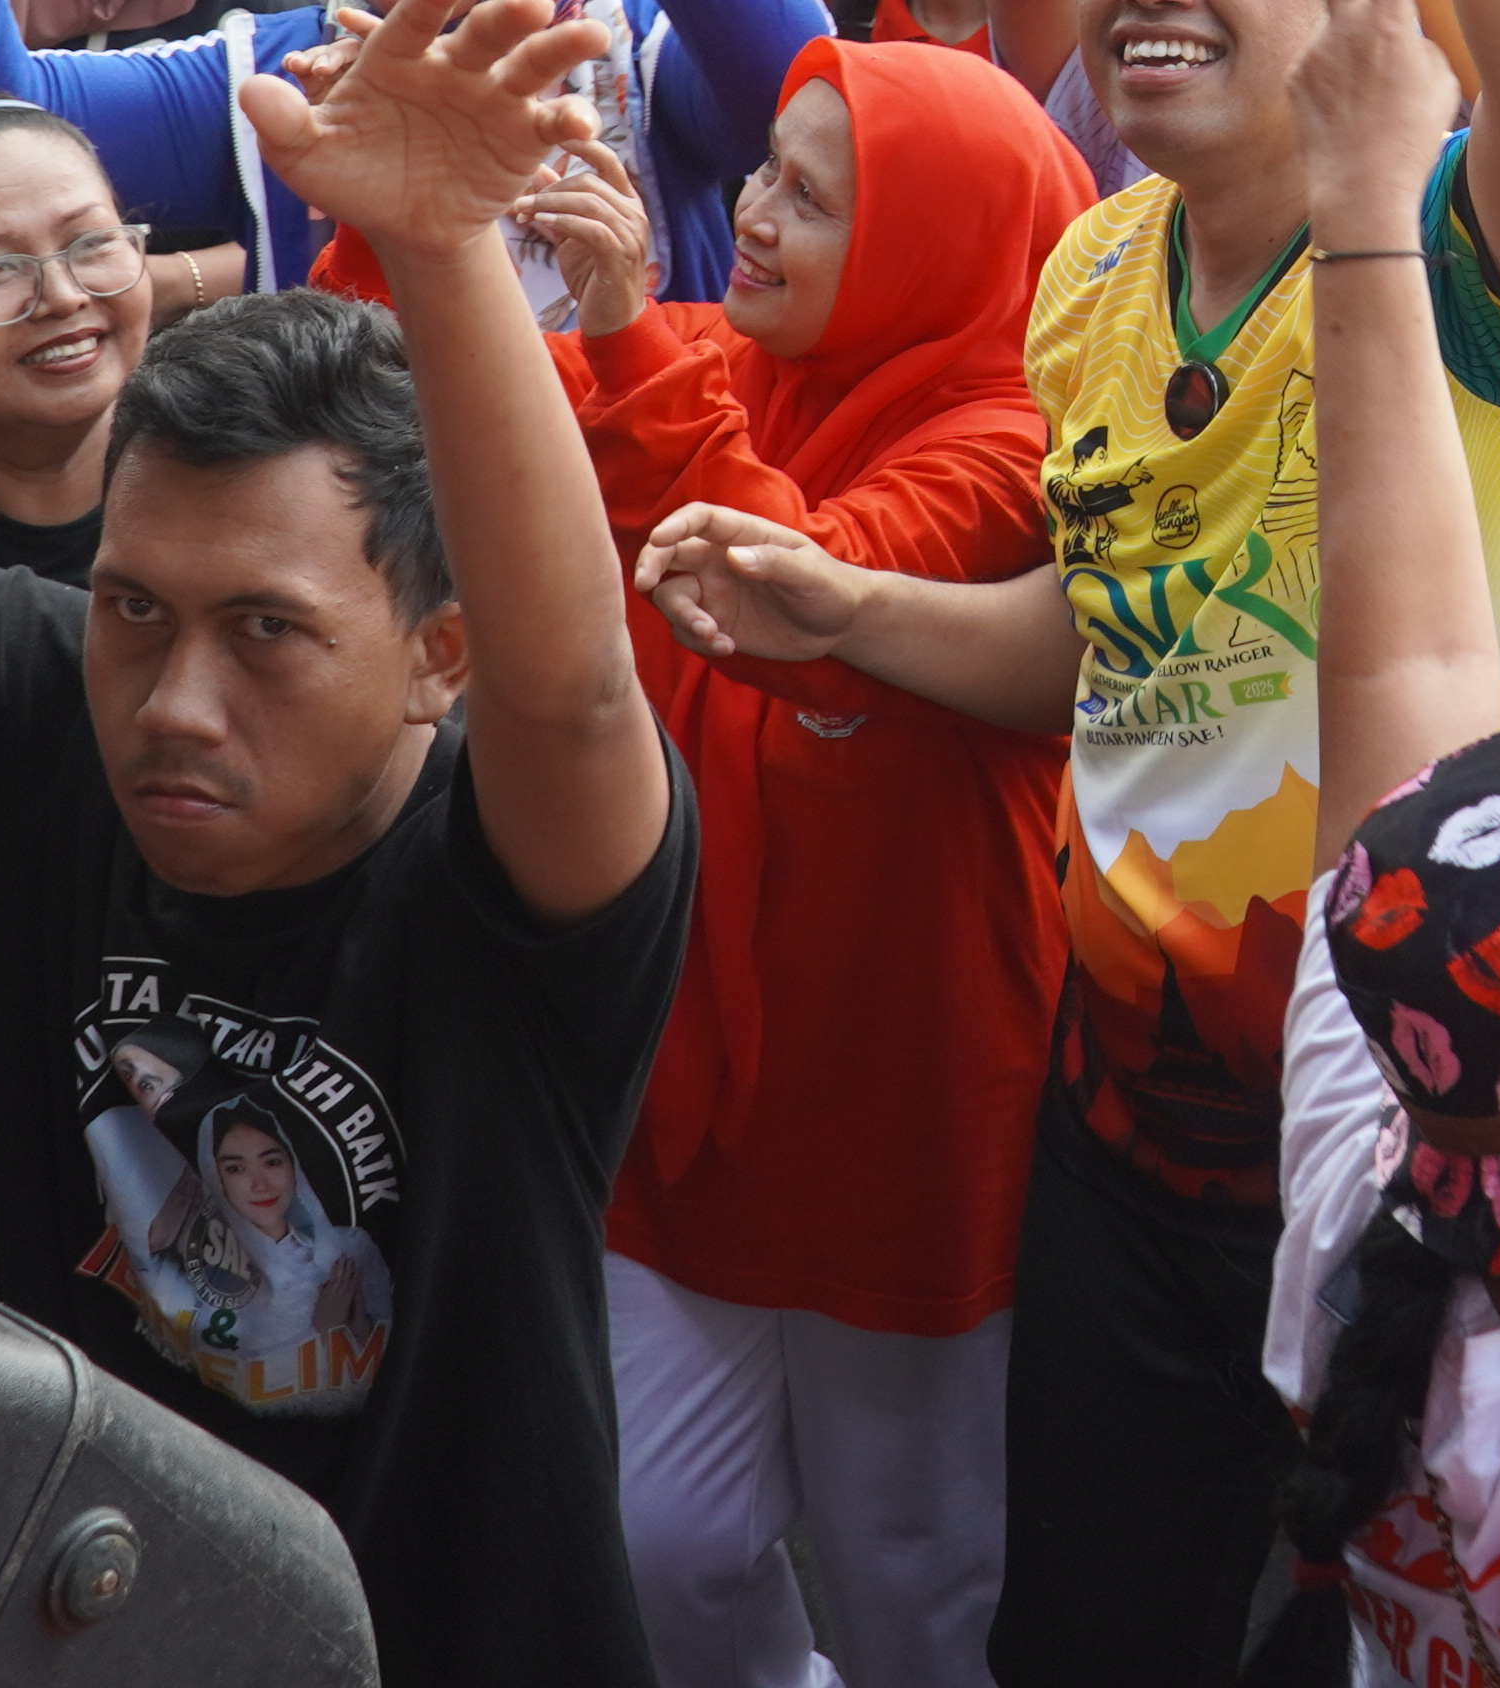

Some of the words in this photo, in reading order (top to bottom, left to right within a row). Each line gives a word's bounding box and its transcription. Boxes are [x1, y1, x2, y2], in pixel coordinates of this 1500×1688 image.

[1205, 645, 1275, 673] RANGER
[1242, 679, 1276, 700] 2025
[1086, 728, 1126, 747] BLITAR
[1125, 730, 1176, 748] PANCEN
[336, 1104, 400, 1212] BAIK
[199, 1319, 390, 1404] ELIM
